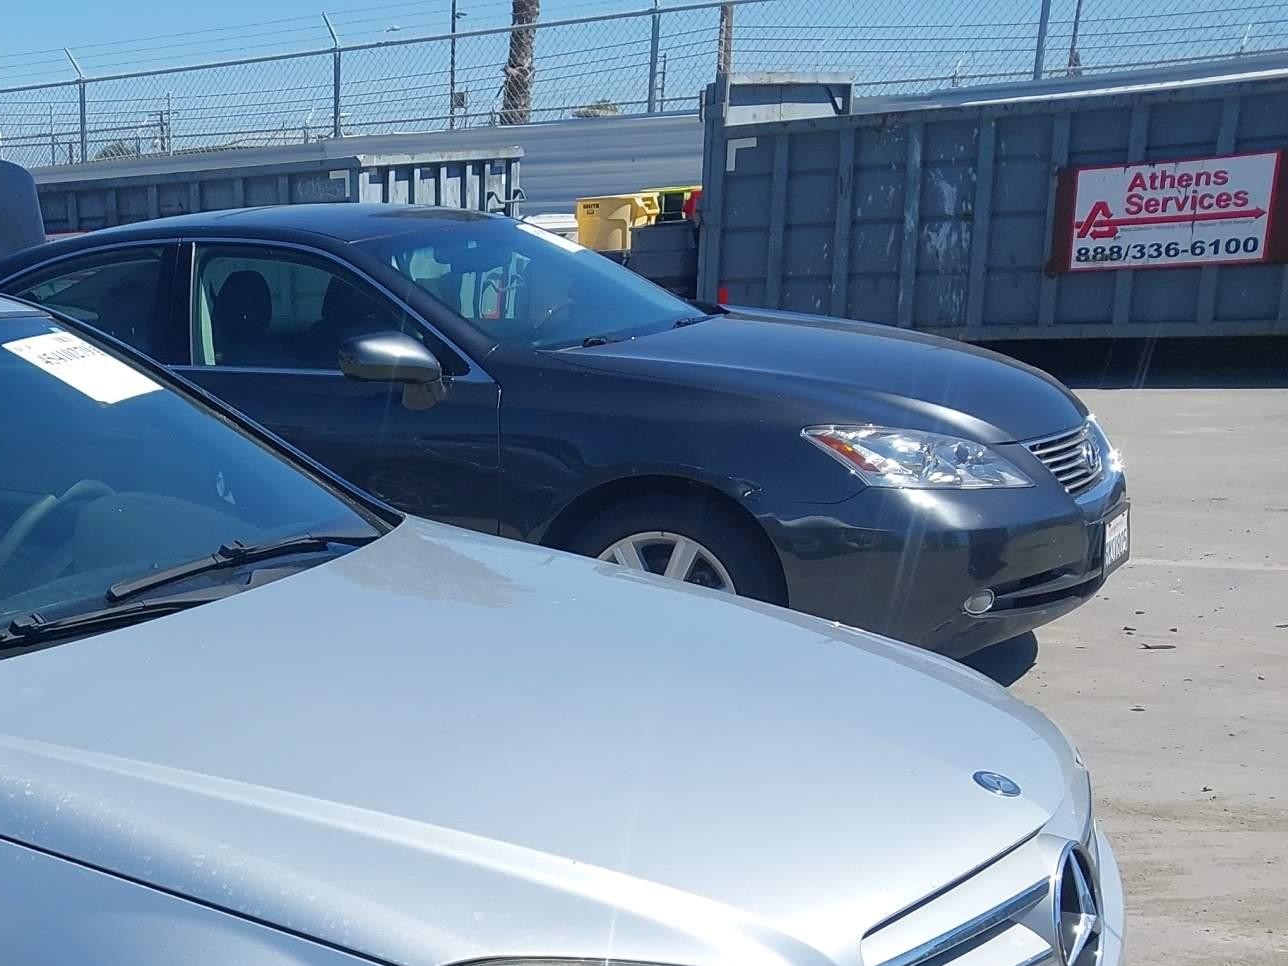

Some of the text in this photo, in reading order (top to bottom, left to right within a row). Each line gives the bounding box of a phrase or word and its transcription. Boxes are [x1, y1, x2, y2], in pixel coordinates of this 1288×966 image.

[1127, 169, 1229, 193] Athens
[1124, 189, 1250, 216] Services
[1075, 237, 1260, 263] 888/336-6100
